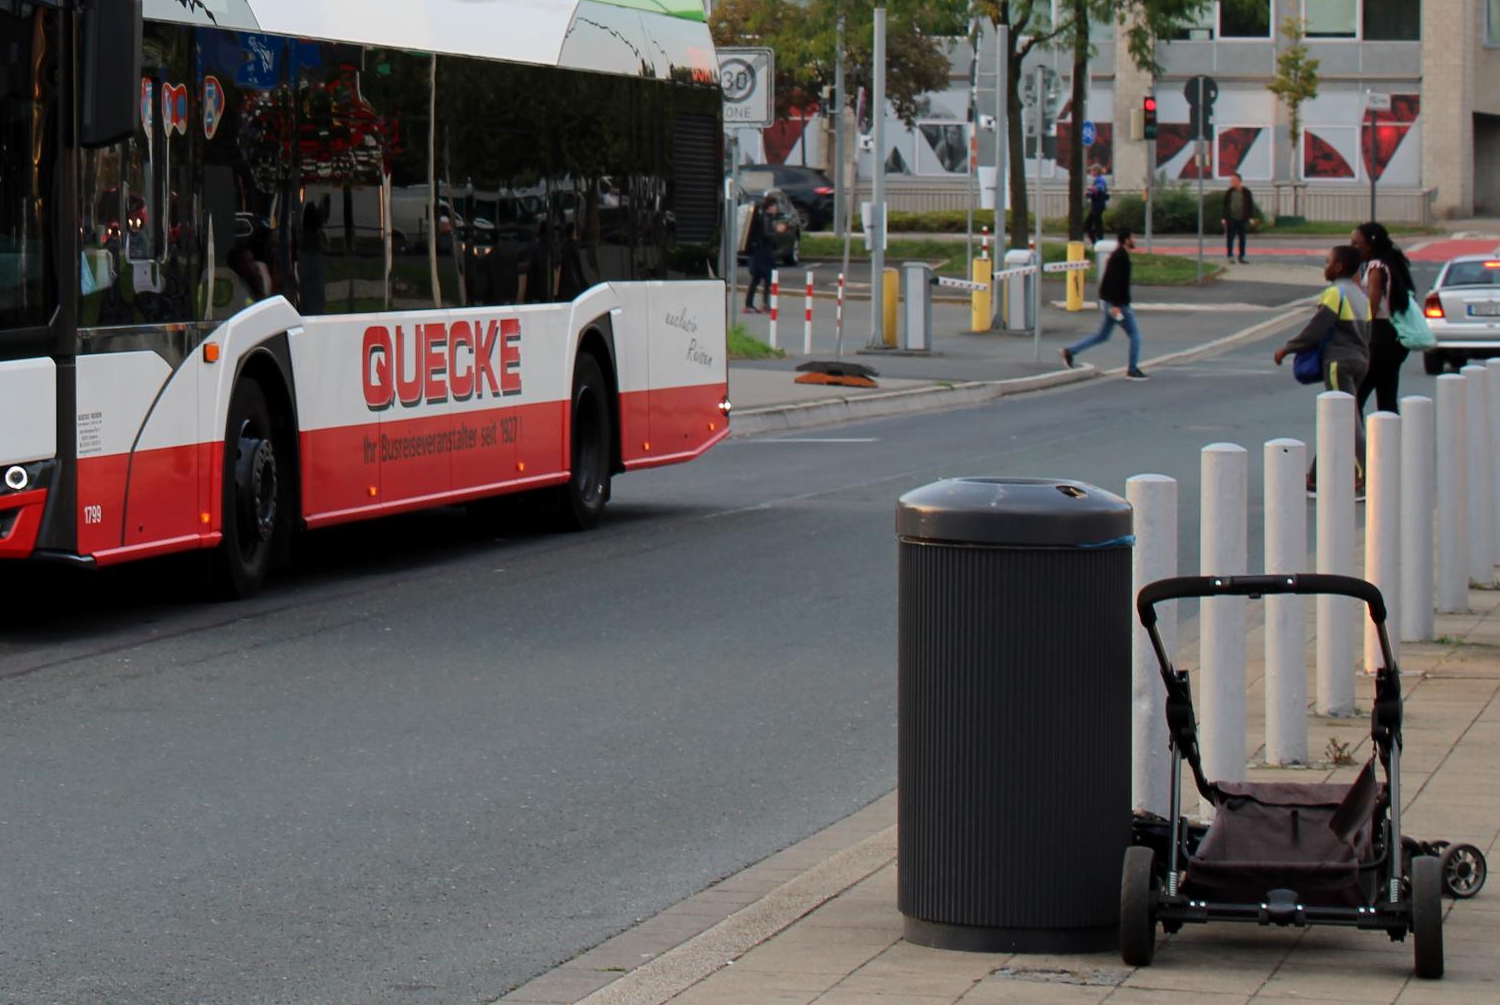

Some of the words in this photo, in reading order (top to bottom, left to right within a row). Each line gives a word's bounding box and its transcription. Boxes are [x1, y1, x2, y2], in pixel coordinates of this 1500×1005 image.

[726, 107, 751, 119] ONE
[362, 318, 522, 412] QUECKE
[364, 434, 376, 465] Ihr
[381, 423, 477, 462] Busreiseveranstalter
[481, 418, 497, 446] seit
[84, 504, 102, 524] 1799
